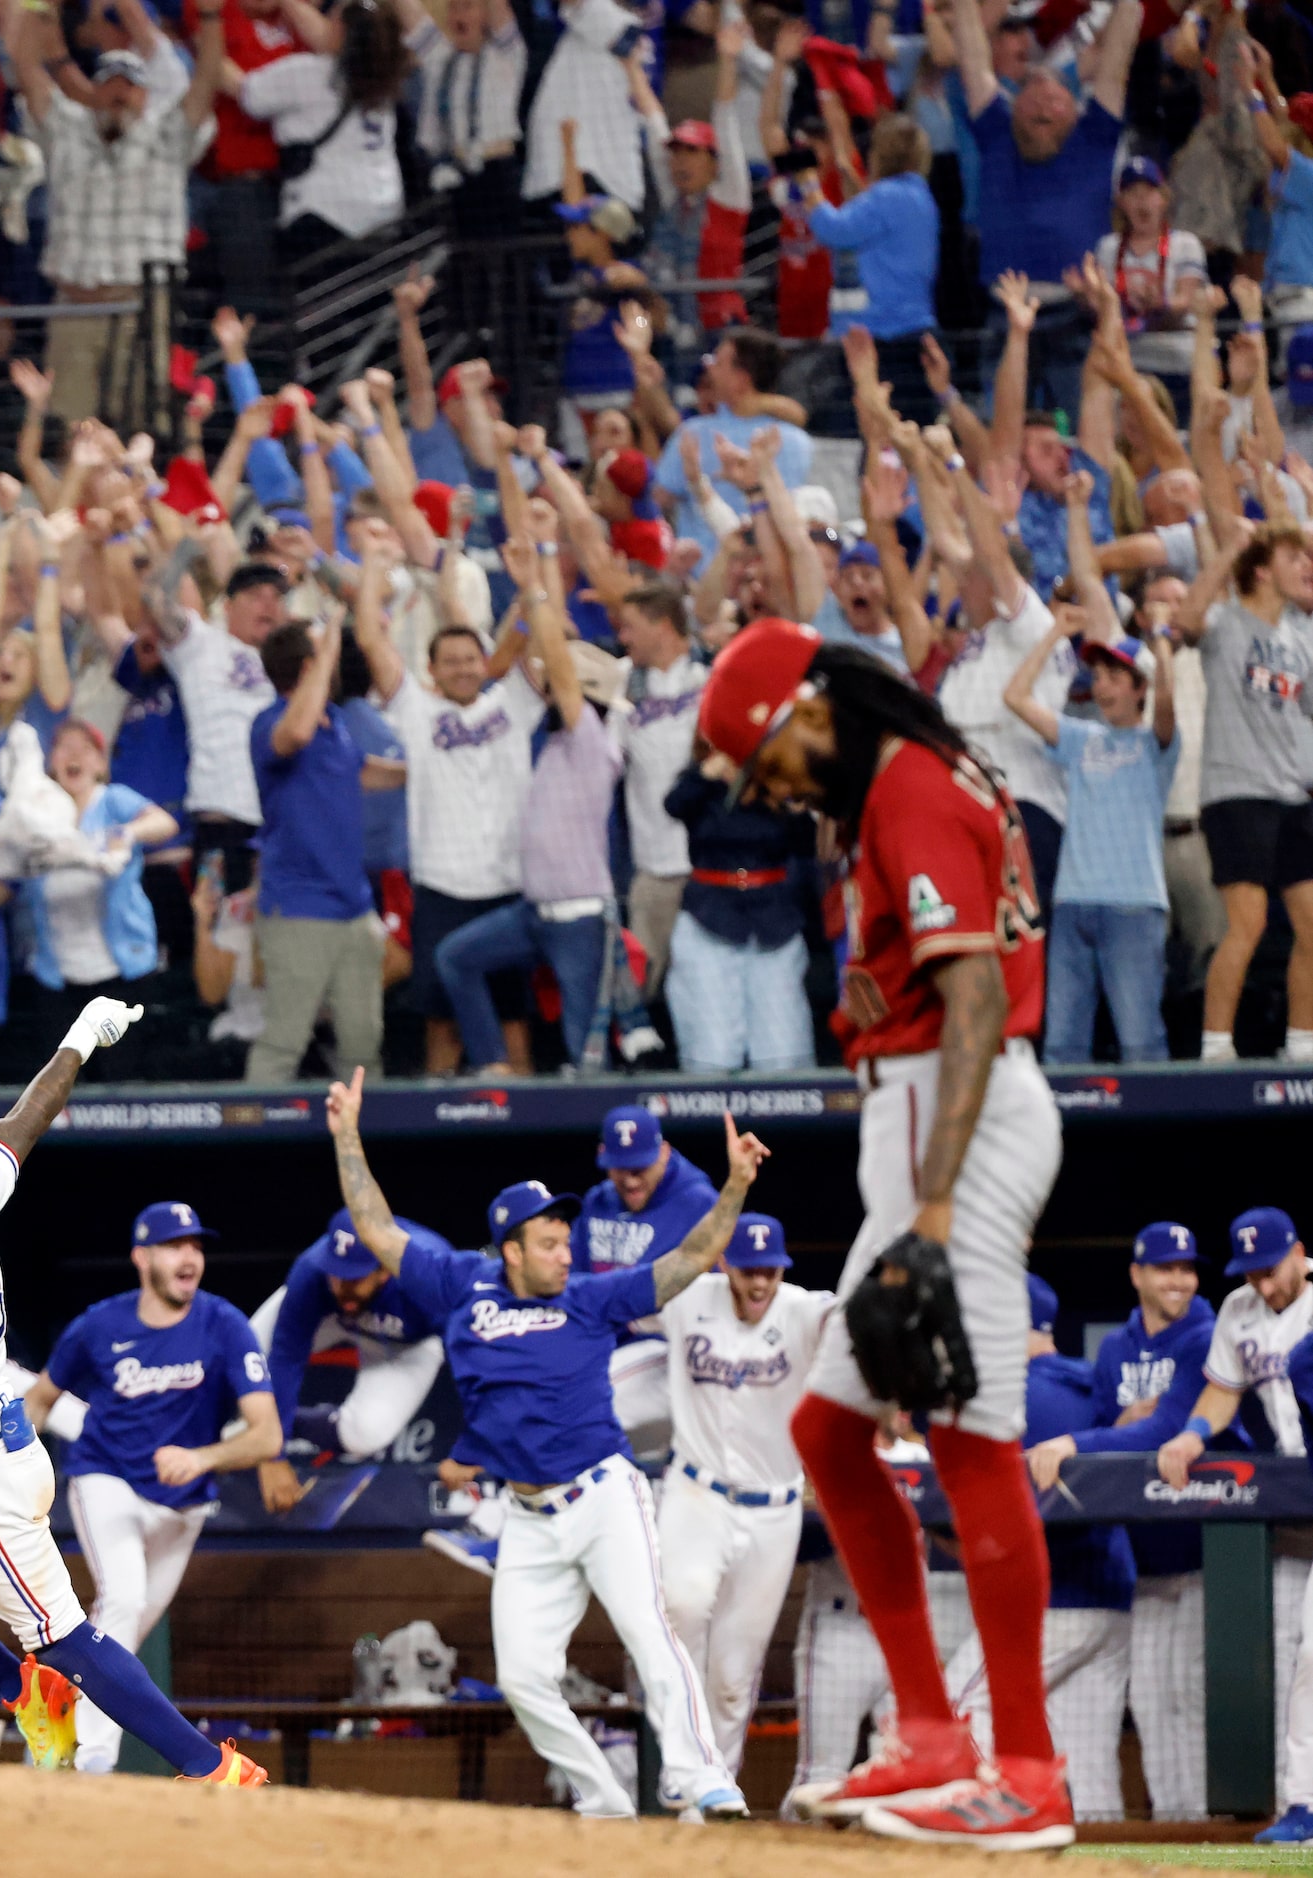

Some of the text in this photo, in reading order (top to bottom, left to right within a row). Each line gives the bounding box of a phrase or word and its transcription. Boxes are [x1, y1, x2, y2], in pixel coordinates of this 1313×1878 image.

[70, 1104, 148, 1130] WORLD
[148, 1102, 222, 1128] SERIES
[669, 1091, 748, 1117] WORLD
[749, 1089, 824, 1116] SERIES
[614, 1120, 638, 1147] T
[170, 1203, 193, 1226] T
[333, 1229, 356, 1257] T
[747, 1224, 770, 1251] T
[1169, 1225, 1190, 1250] T
[1237, 1225, 1258, 1253] T
[470, 1299, 568, 1341] Rangers
[113, 1357, 204, 1398] Rangers
